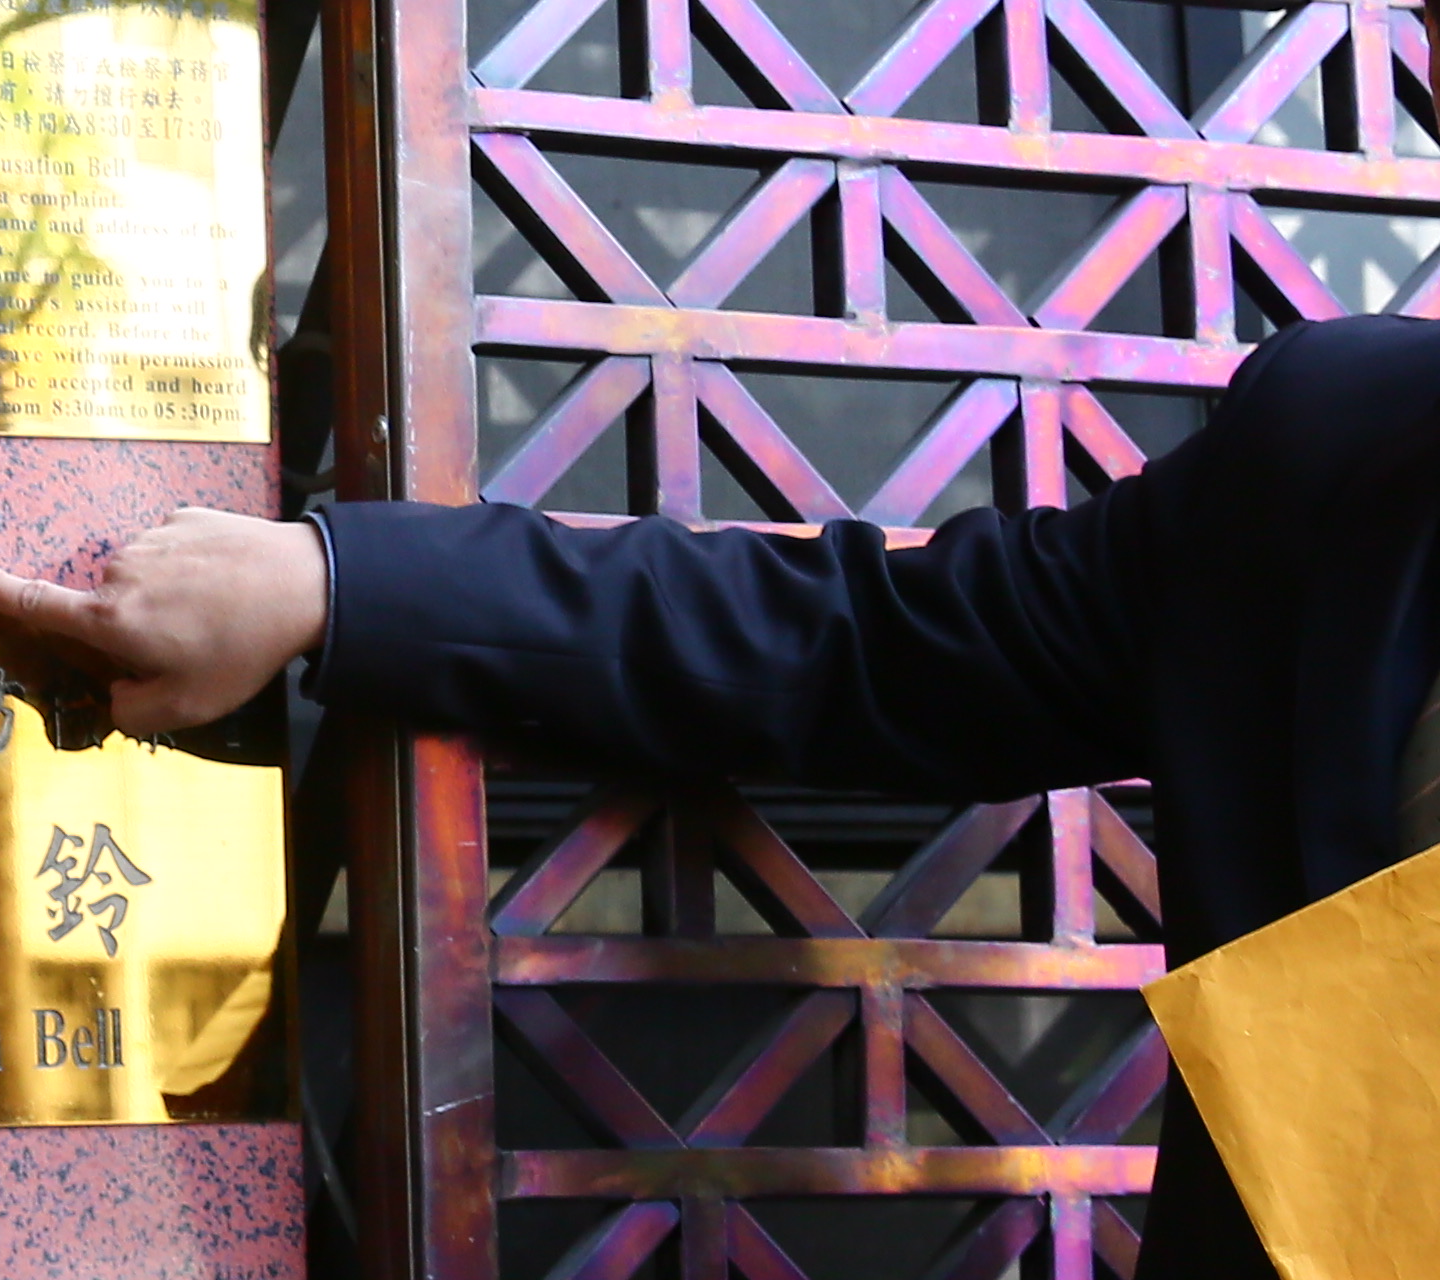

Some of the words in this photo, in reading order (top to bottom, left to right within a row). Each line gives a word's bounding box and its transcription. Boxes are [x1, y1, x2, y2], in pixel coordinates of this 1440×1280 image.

[88, 155, 127, 179] Bell
[48, 217, 85, 235] and
[179, 222, 200, 238] of
[210, 223, 238, 240] the
[72, 270, 124, 290] guide
[140, 276, 174, 292] you
[186, 274, 203, 290] to
[219, 278, 229, 291] a
[75, 296, 160, 314] assistant
[172, 299, 207, 316] will
[108, 322, 170, 341] Before
[182, 324, 211, 341] the
[53, 349, 130, 366] without
[14, 370, 37, 389] be
[48, 375, 133, 395] accepted
[146, 377, 180, 394] and
[192, 378, 247, 395] heard
[130, 400, 148, 419] to
[33, 1007, 125, 1070] Bell
